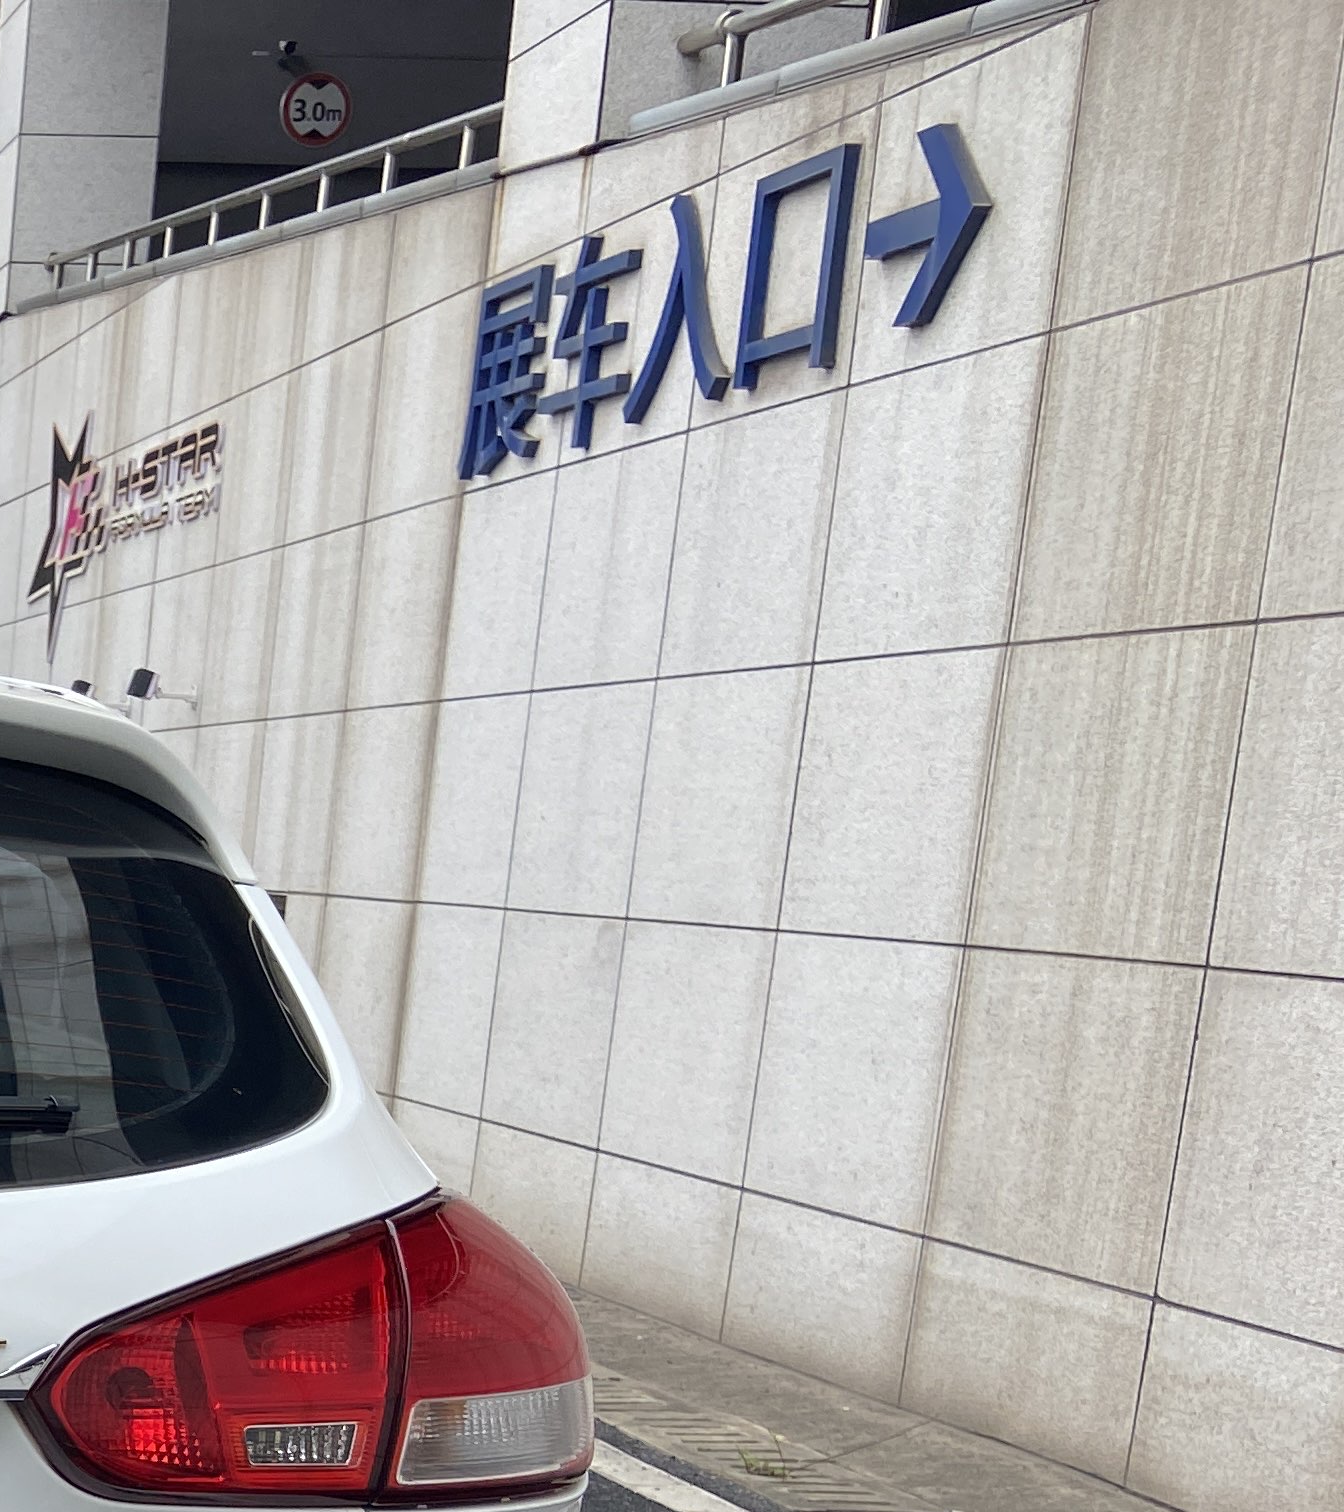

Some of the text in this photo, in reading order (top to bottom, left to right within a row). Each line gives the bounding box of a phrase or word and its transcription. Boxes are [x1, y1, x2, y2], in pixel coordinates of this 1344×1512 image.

[292, 98, 343, 123] 3.0m
[458, 142, 864, 481] 展车入口
[112, 420, 225, 508] H-STAR
